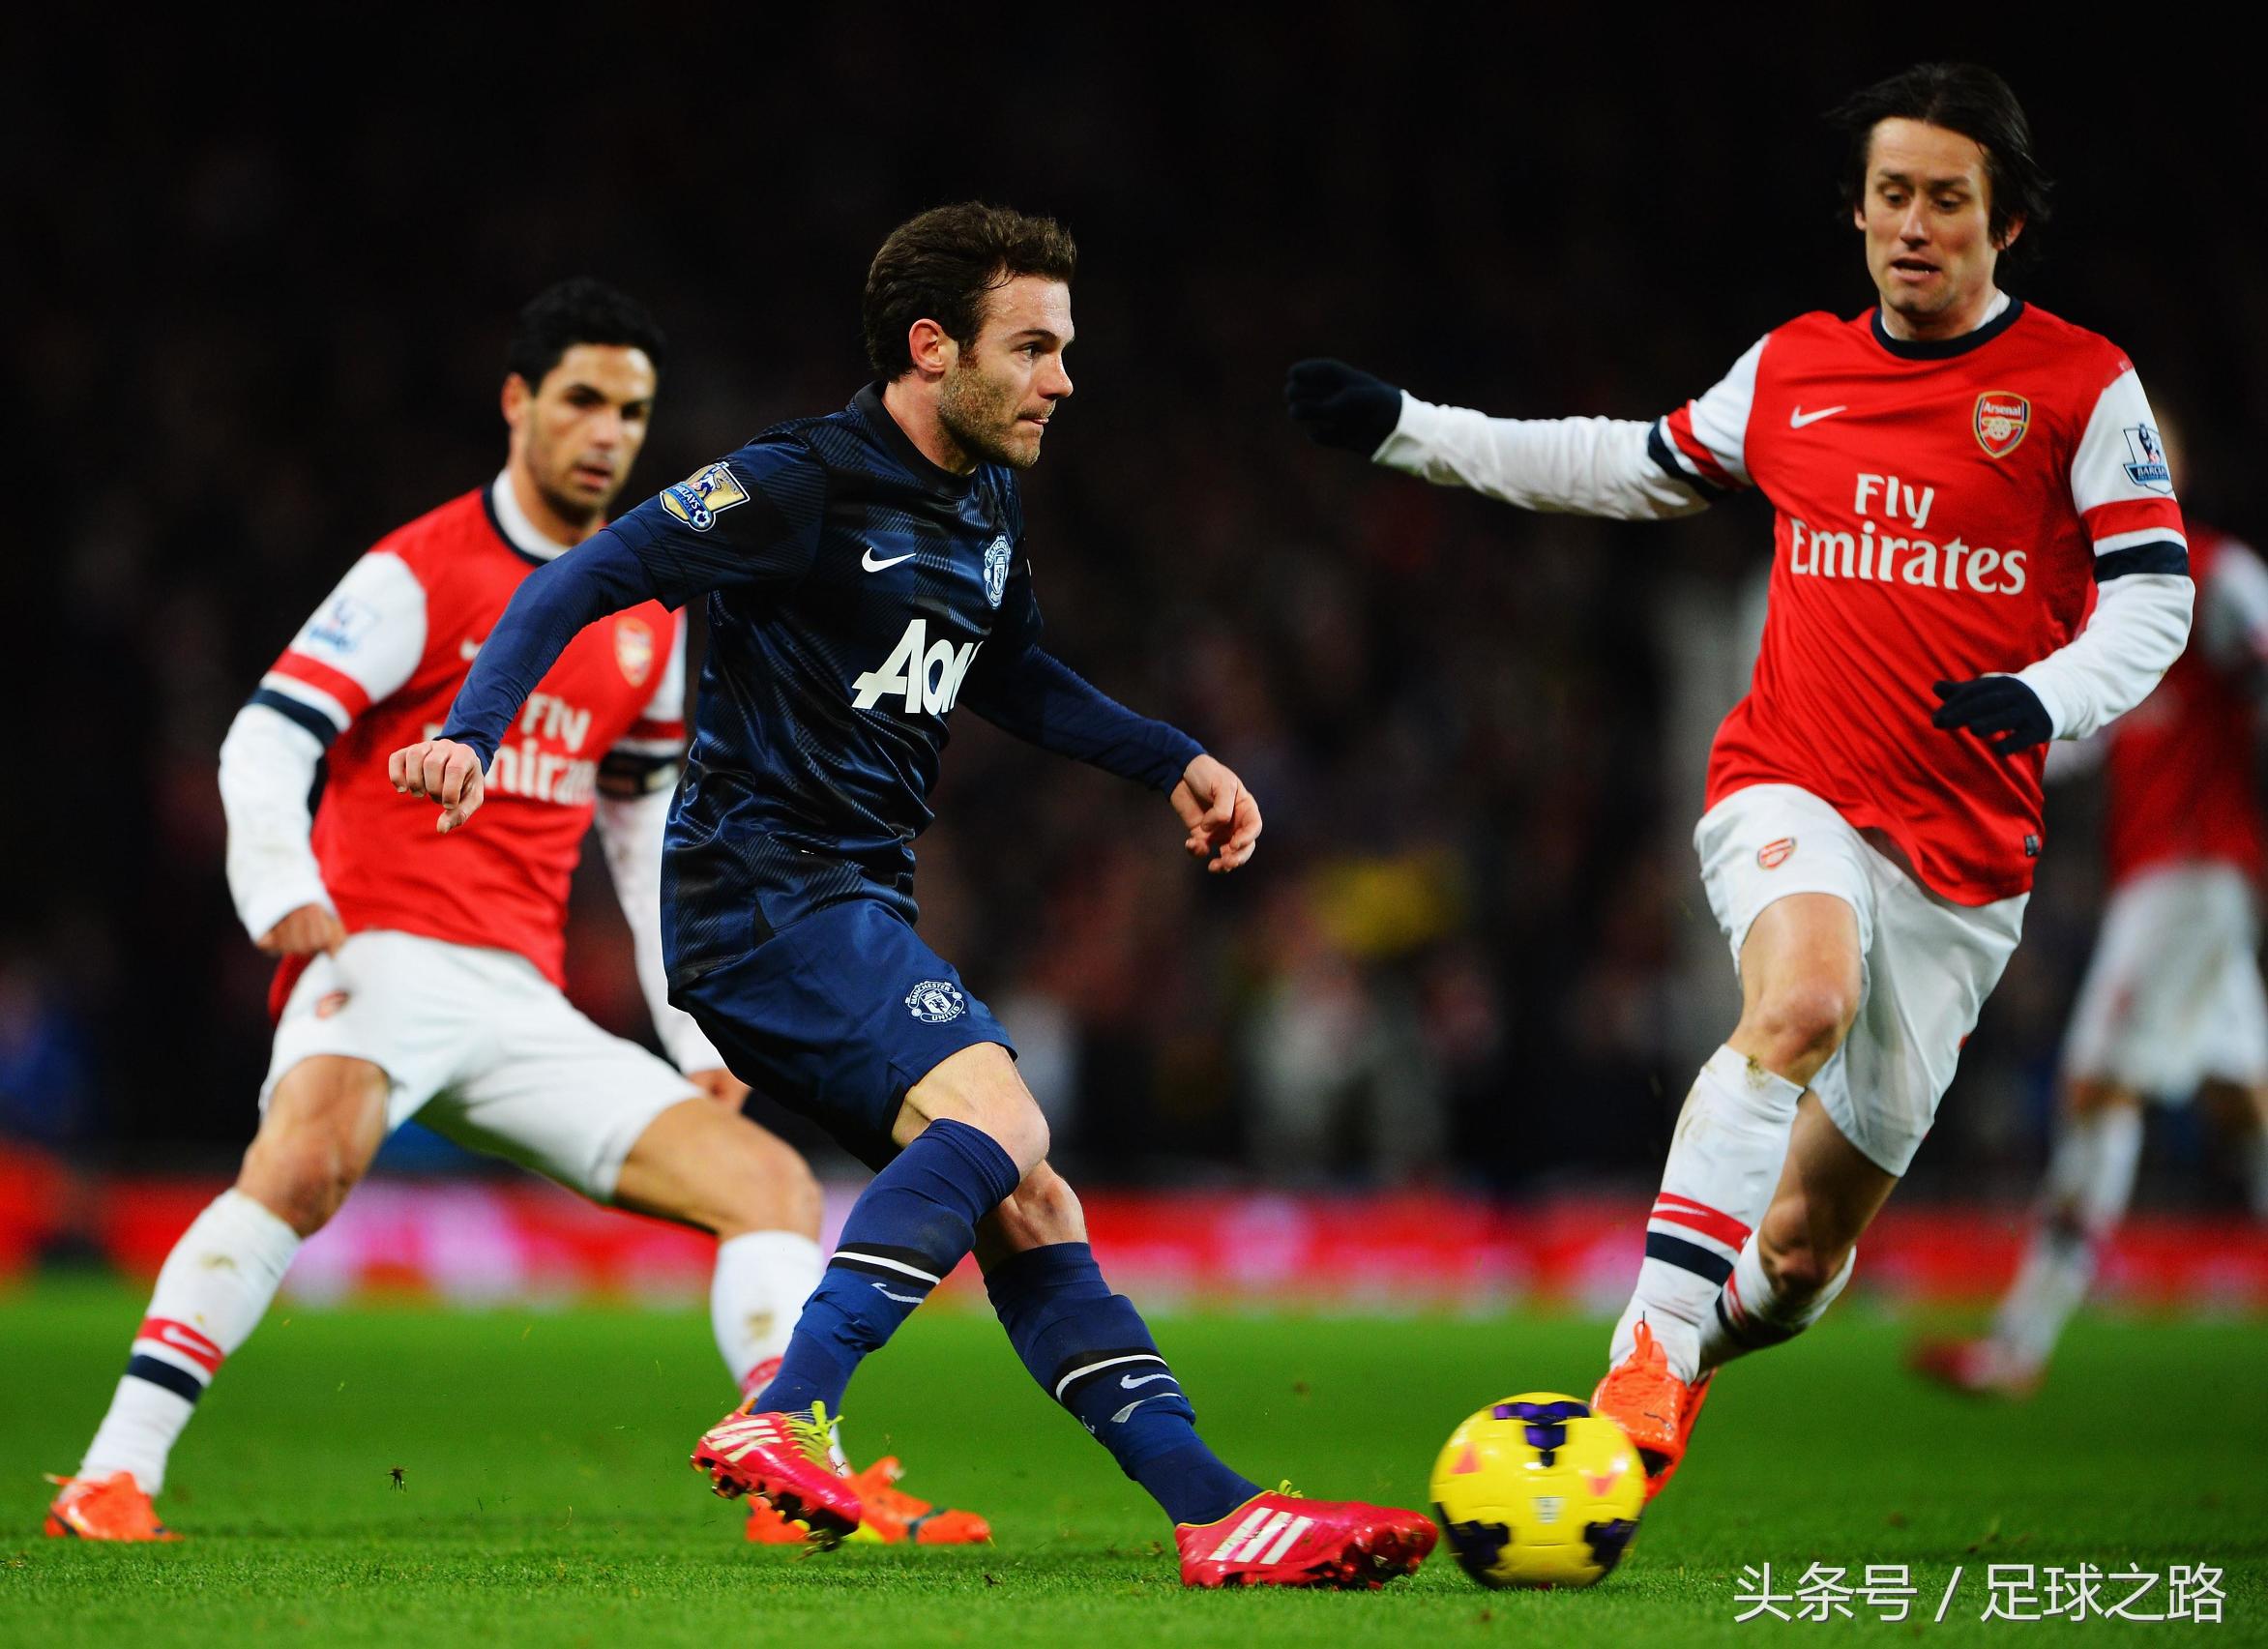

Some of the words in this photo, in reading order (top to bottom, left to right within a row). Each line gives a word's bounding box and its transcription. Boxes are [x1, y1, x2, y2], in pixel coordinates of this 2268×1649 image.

[1983, 400, 2021, 417] Arsenal
[2135, 465, 2168, 477] BARCL
[671, 484, 701, 510] RCLAYS
[1854, 472, 1935, 530] Fly
[1789, 516, 2027, 596] Emirates
[518, 691, 592, 754] Fly
[910, 983, 952, 1005] MANCHESTER
[931, 1006, 960, 1021] UNITED
